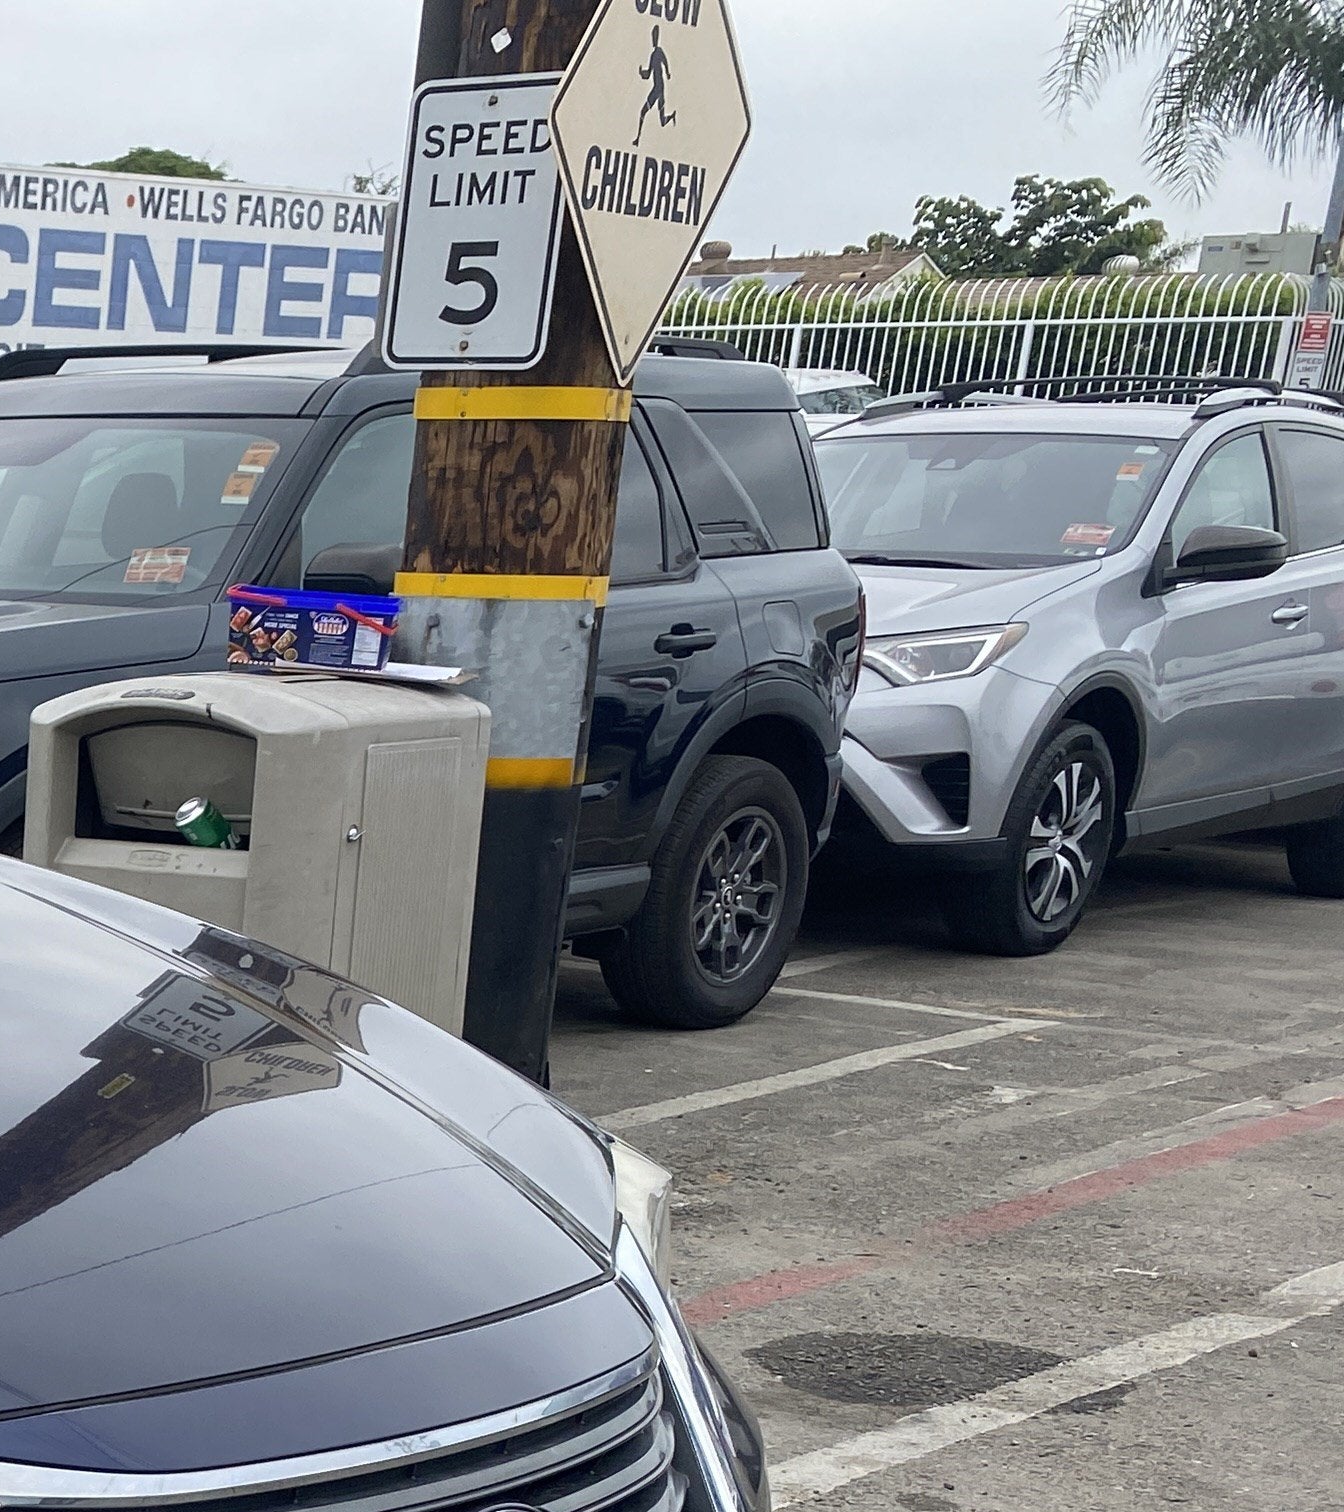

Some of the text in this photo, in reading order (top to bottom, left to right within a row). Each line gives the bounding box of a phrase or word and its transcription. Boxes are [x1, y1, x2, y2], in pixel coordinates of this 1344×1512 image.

[422, 119, 551, 159] SPEED
[429, 168, 536, 208] LIMIT
[582, 145, 706, 227] CHILDREN
[137, 186, 227, 224] WELLS
[236, 194, 324, 232] FARGO
[333, 202, 386, 236] BAN
[438, 241, 500, 326] 5
[1296, 357, 1323, 365] SPEED
